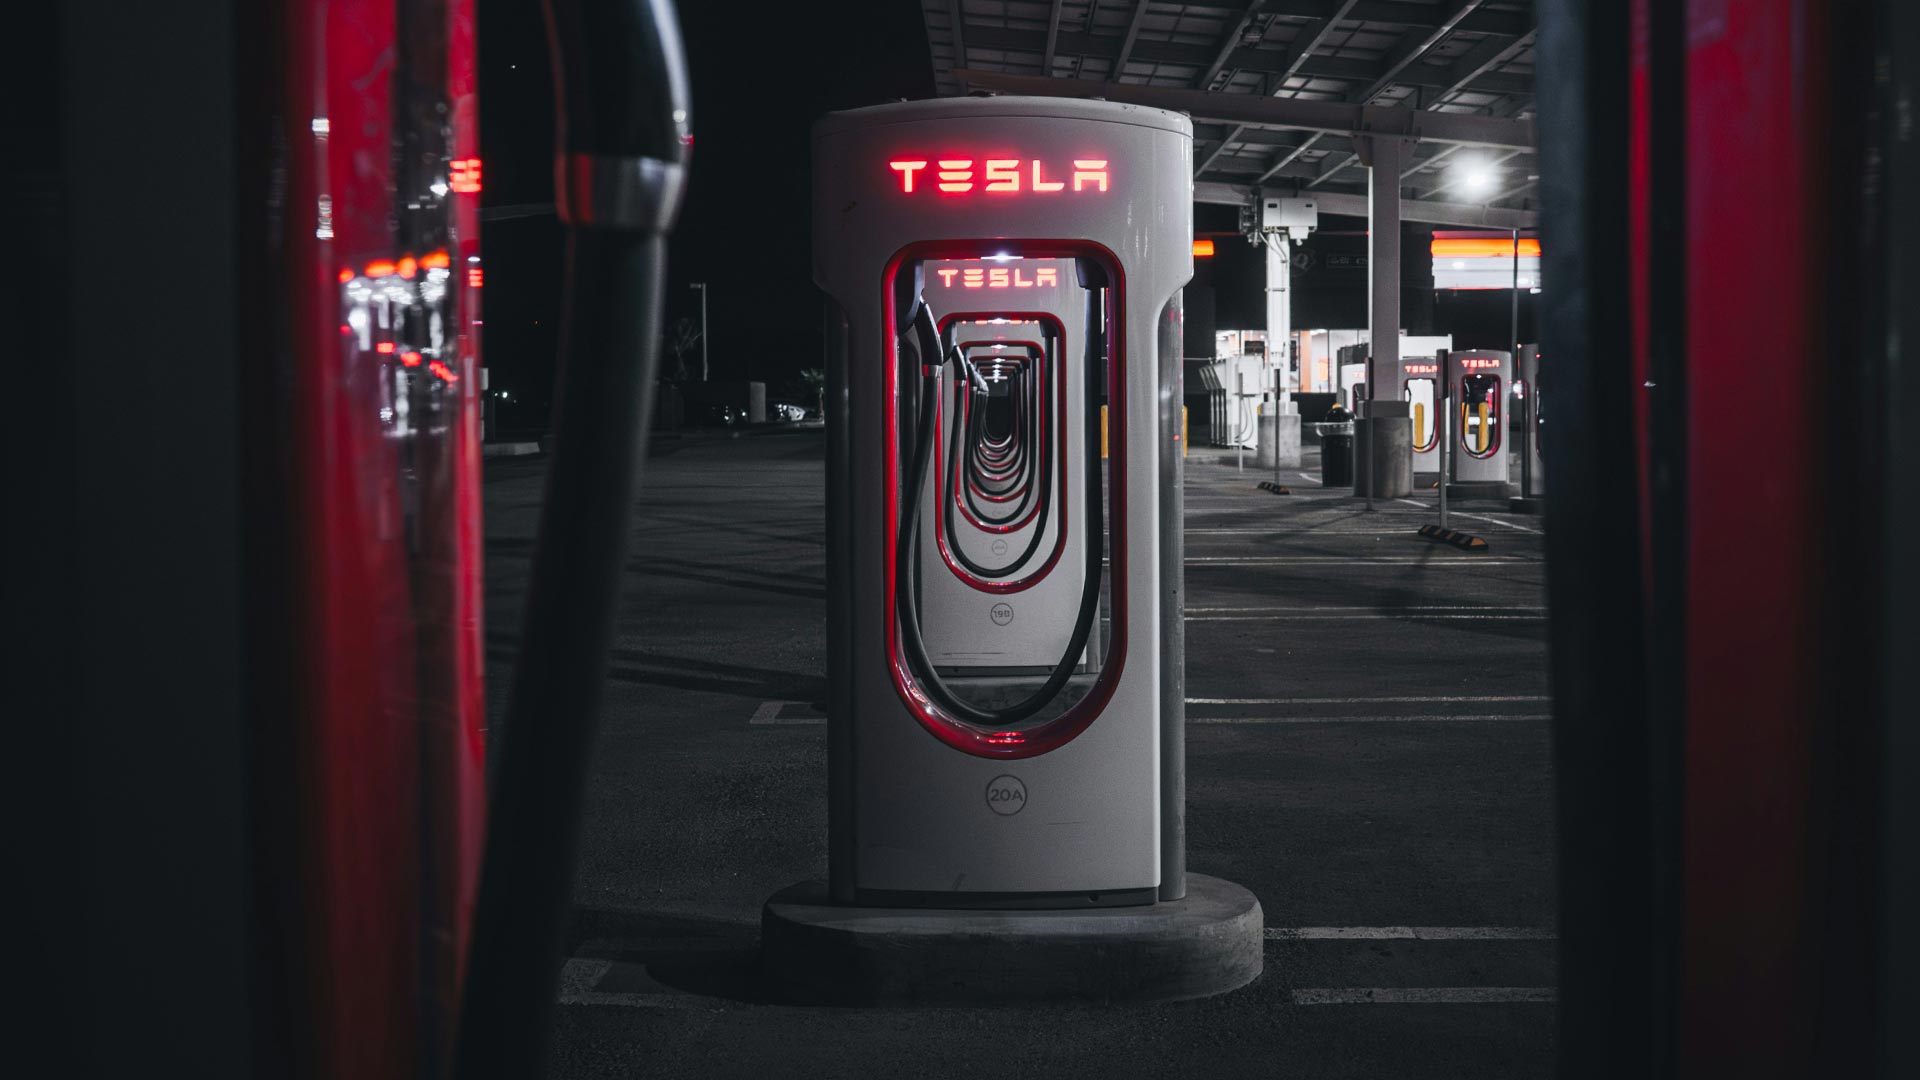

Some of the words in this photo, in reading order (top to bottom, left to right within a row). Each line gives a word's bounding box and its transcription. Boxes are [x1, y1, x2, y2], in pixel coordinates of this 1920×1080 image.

[889, 160, 1108, 193] TESLA
[937, 268, 1057, 288] TESLA
[1461, 359, 1501, 368] TESLA
[990, 788, 1024, 802] 20A
